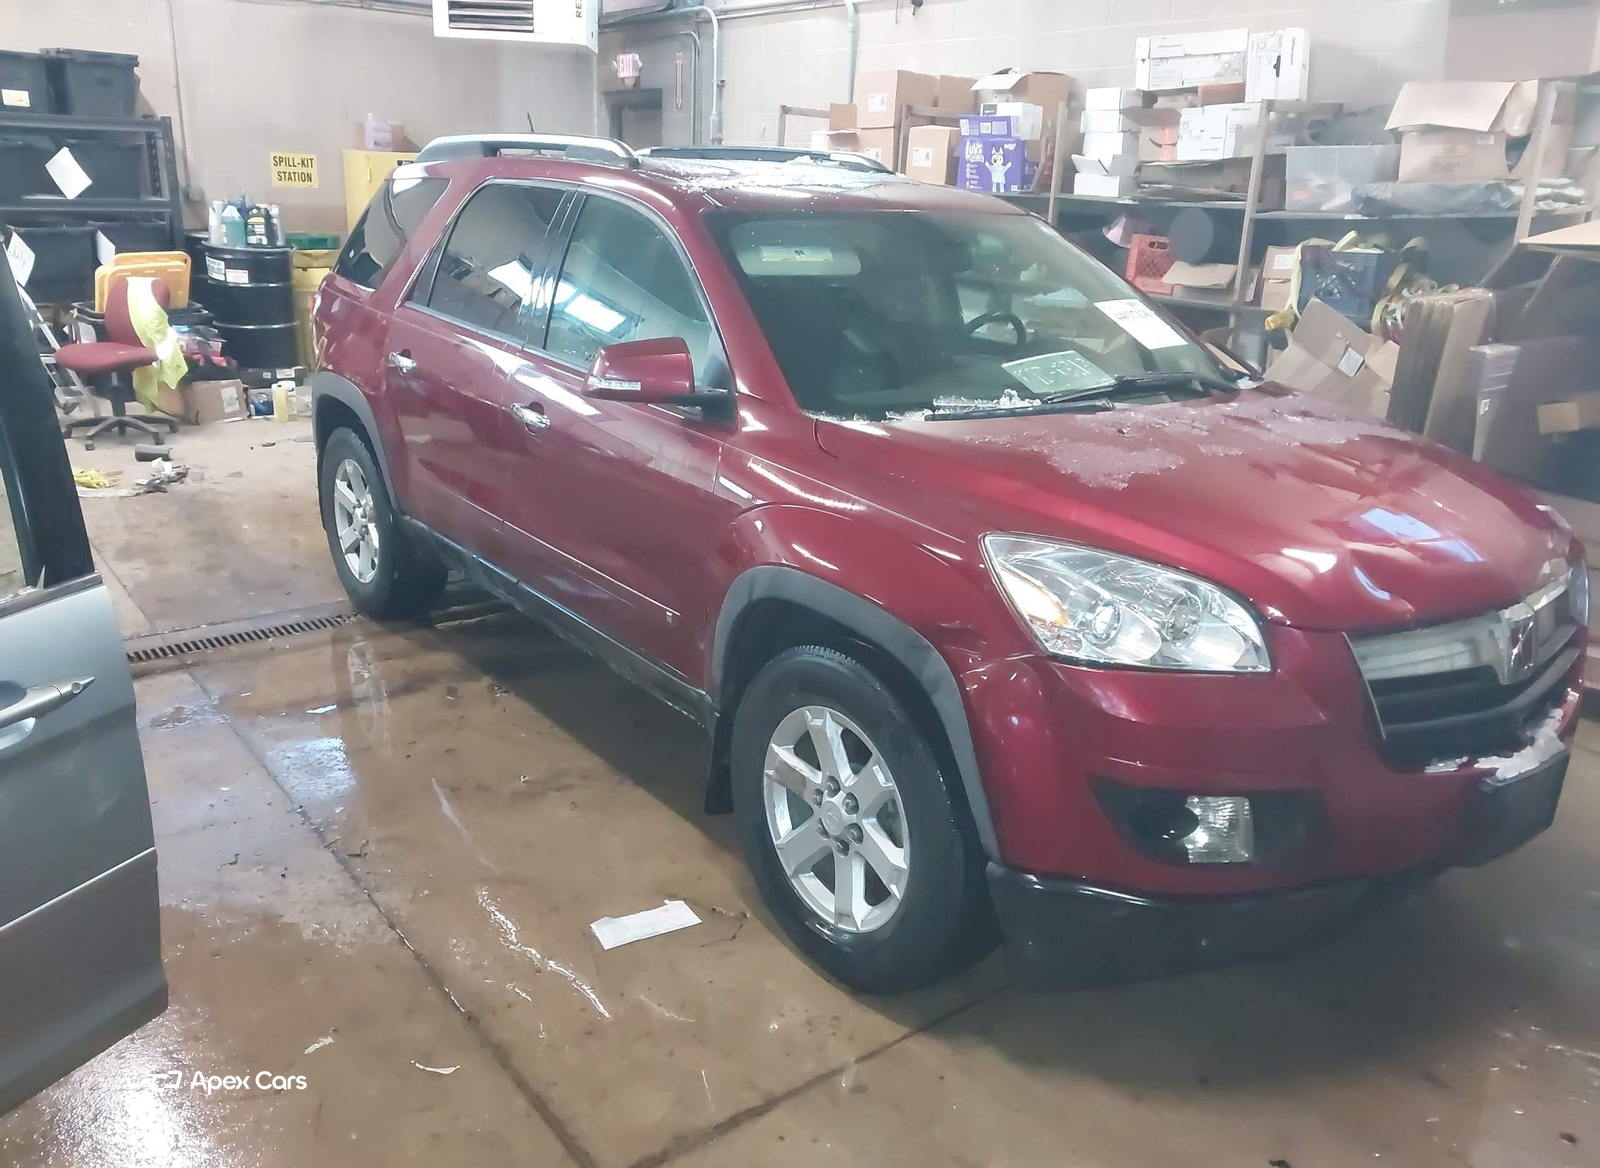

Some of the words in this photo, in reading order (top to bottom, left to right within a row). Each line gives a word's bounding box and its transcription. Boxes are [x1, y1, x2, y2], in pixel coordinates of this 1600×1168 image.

[575, 0, 583, 18] RE
[272, 155, 315, 169] SPILL-KIT
[277, 170, 313, 183] STATION
